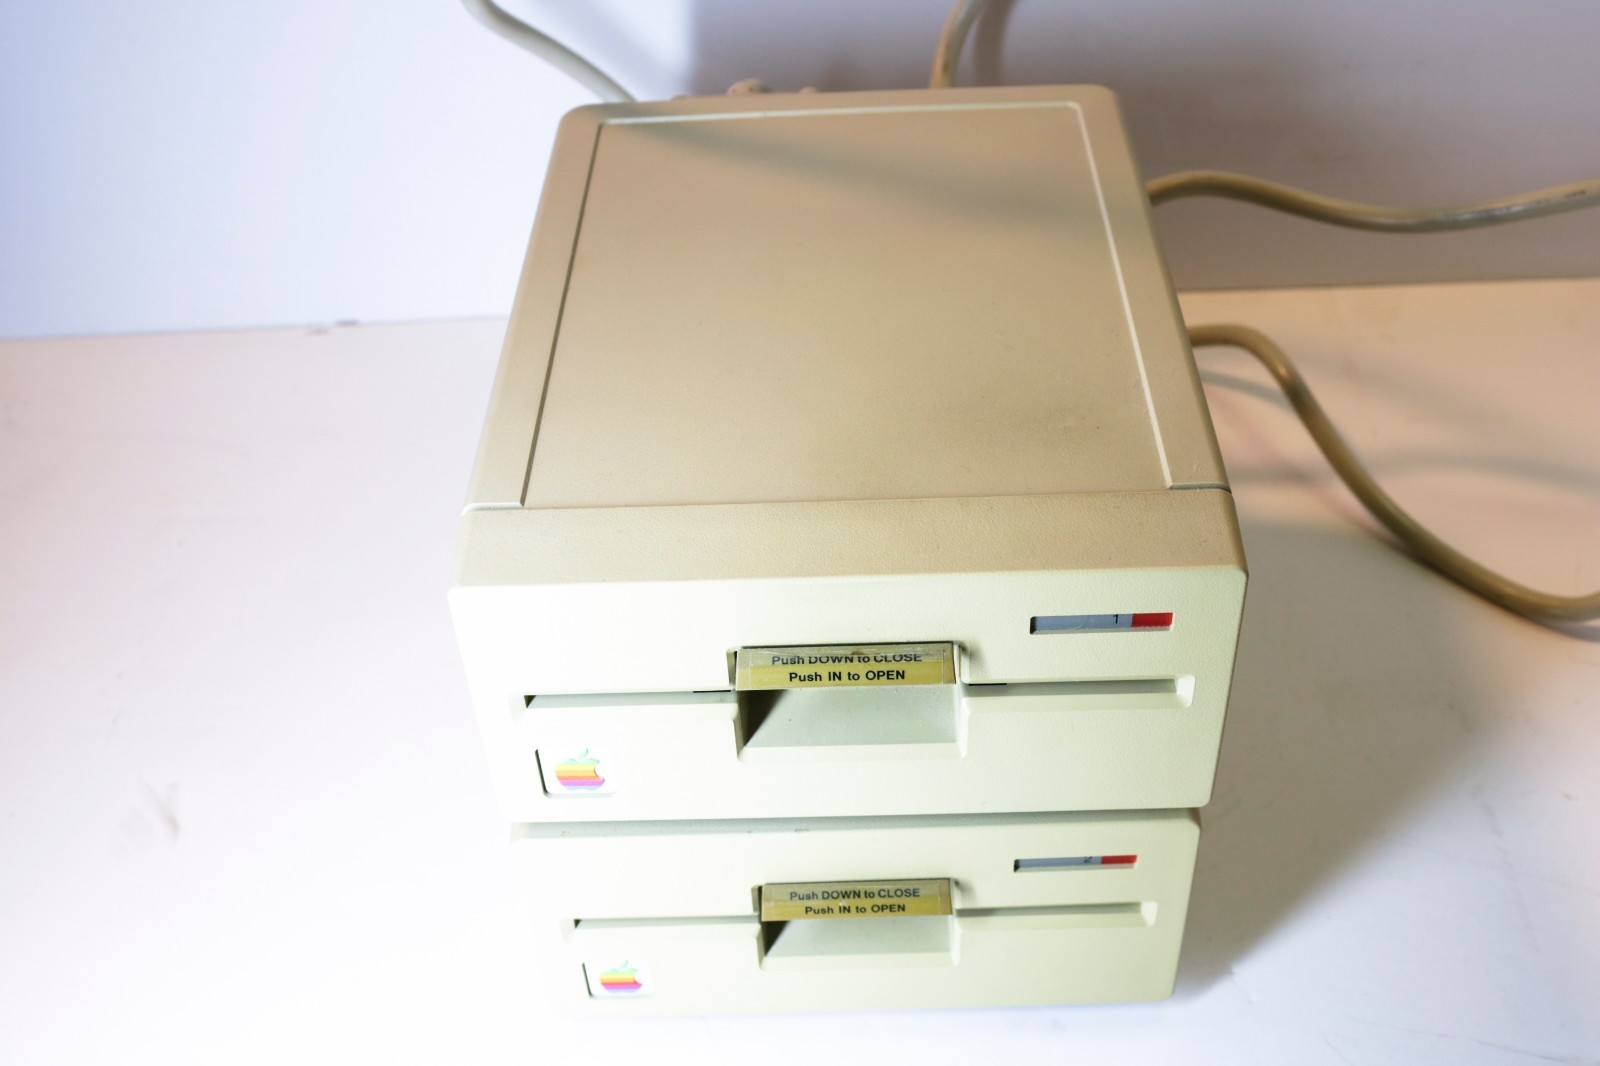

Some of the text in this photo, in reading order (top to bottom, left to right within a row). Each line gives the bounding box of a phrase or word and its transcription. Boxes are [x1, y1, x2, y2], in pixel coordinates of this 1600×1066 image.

[1113, 614, 1119, 624] 1
[771, 653, 923, 665] Push DOWN to CLOSE
[789, 670, 906, 682] Push IN to OPEN
[790, 888, 920, 901] Push DOWN to CLOSE
[804, 904, 906, 915] Push IN to OPEN
